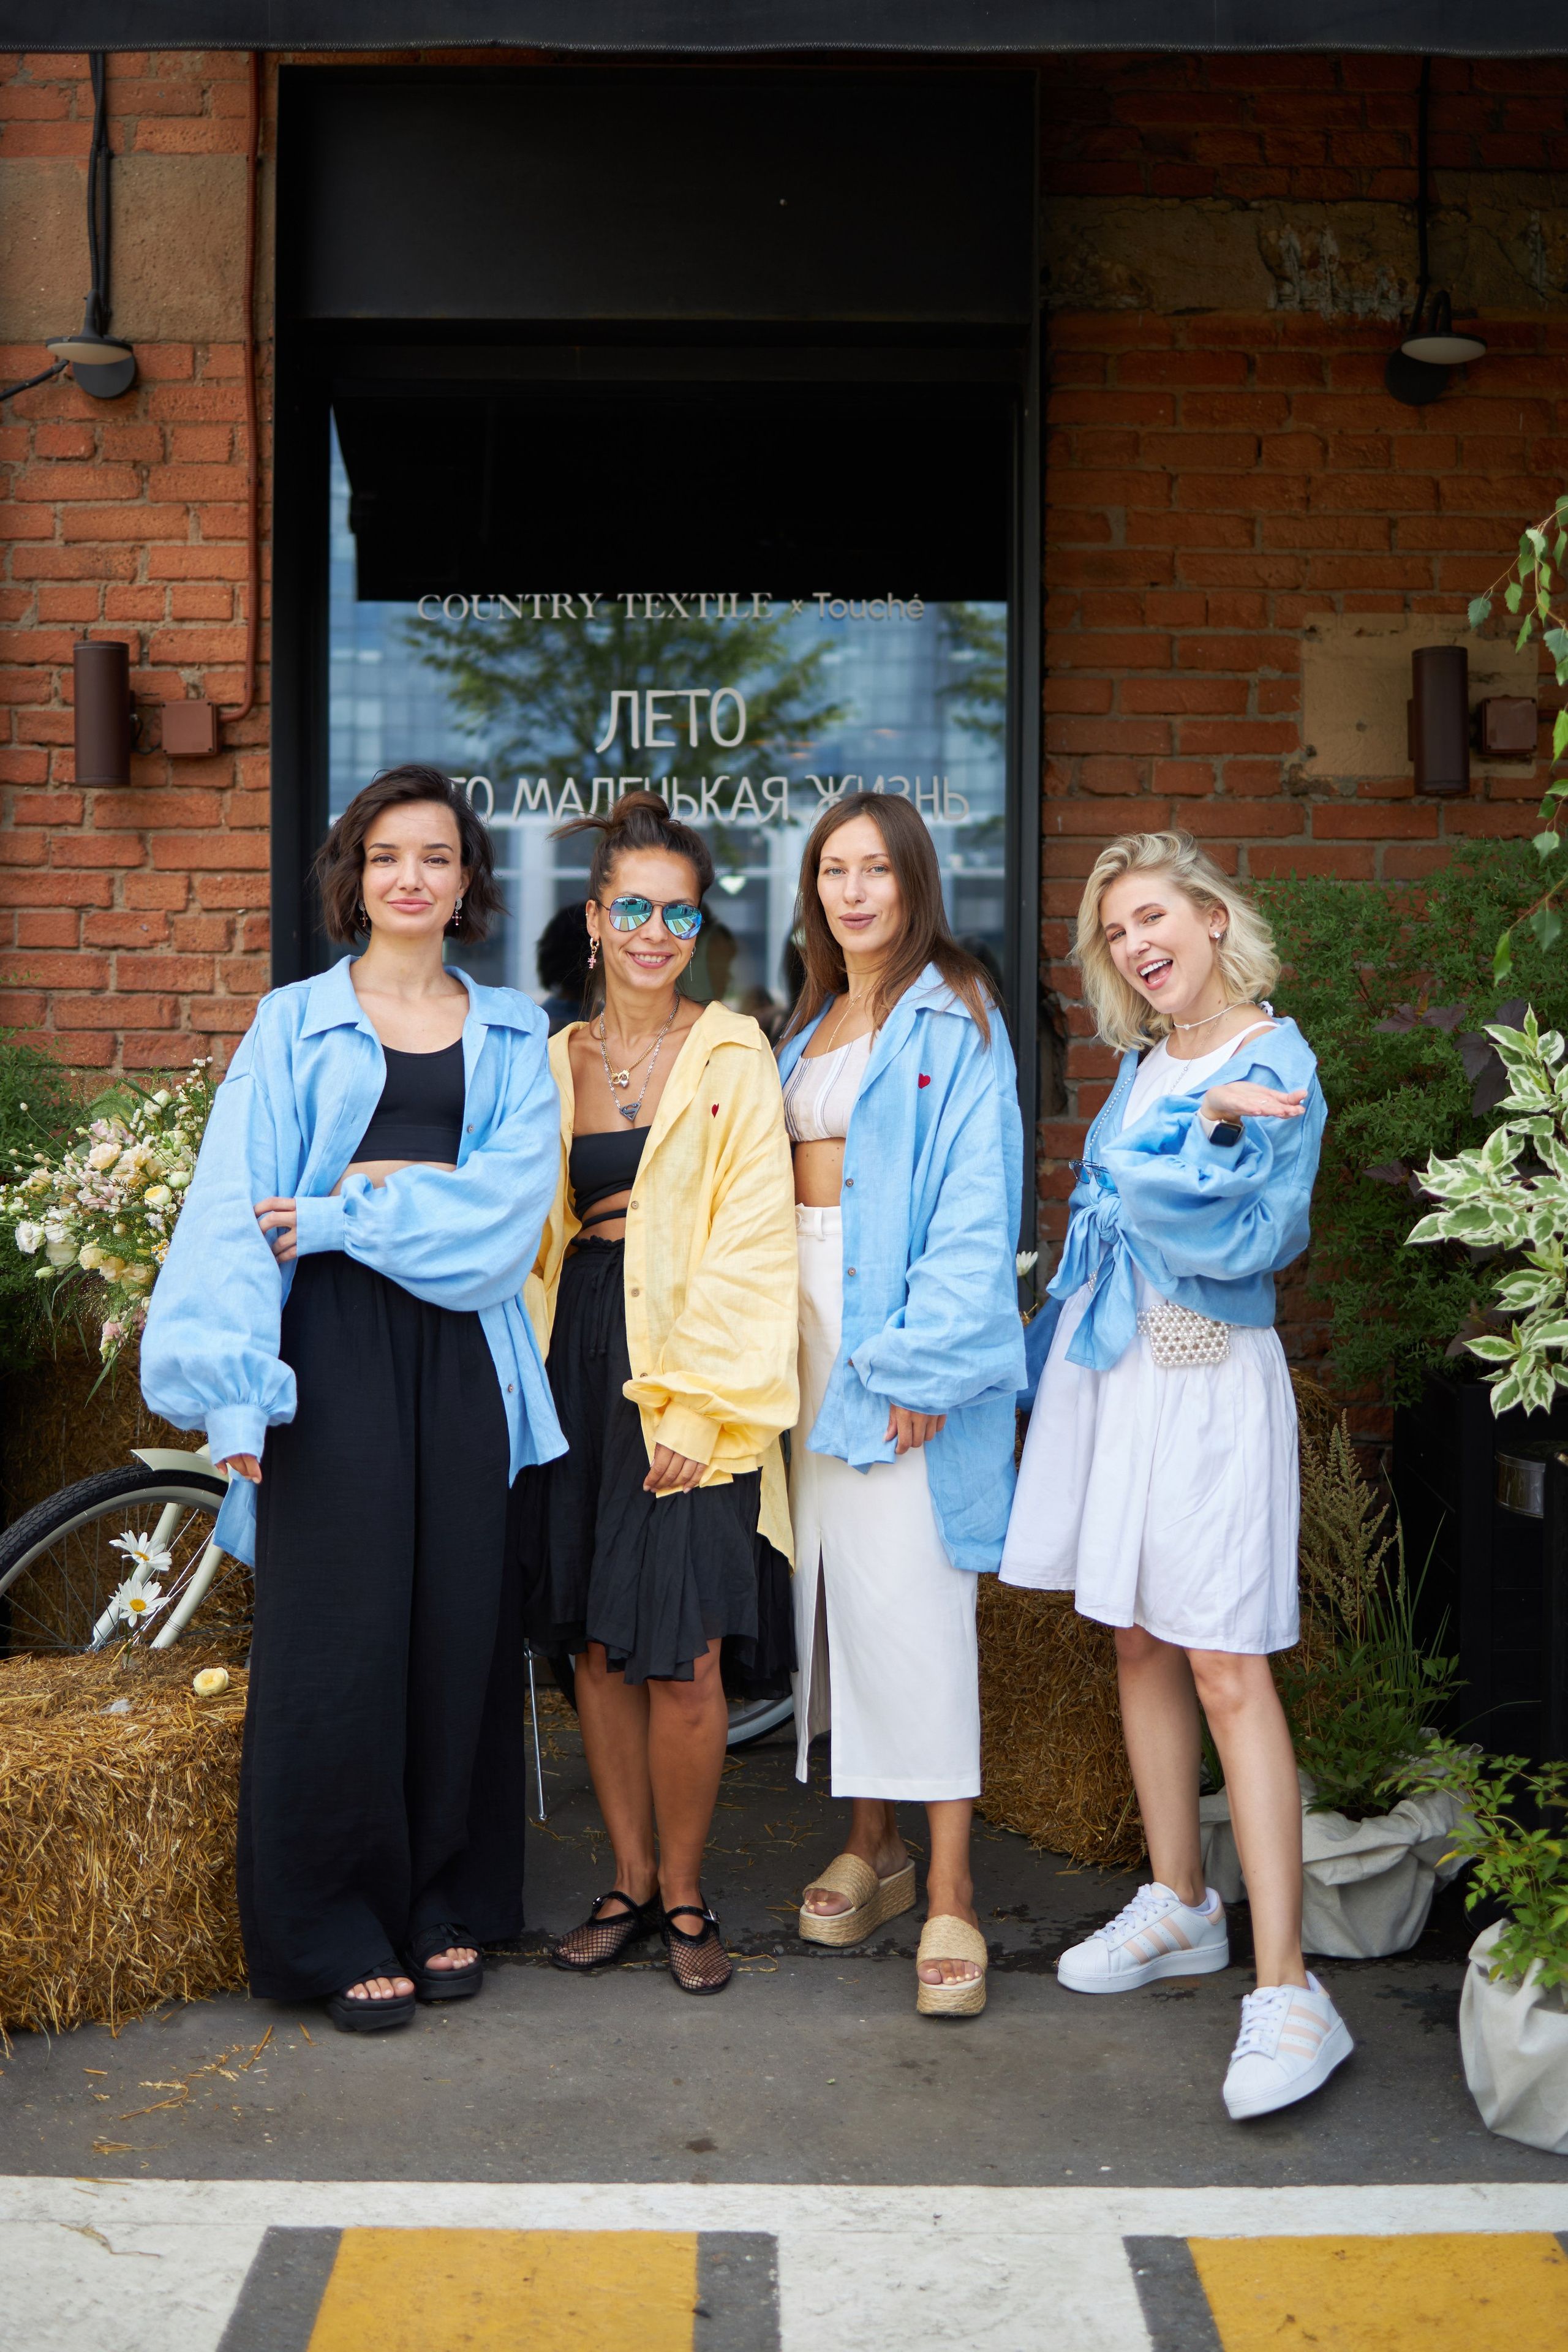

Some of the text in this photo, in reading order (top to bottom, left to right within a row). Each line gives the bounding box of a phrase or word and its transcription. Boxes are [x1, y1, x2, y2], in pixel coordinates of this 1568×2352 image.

[417, 593, 603, 620] COUNTRY
[617, 592, 773, 619] TEXTILE
[812, 592, 925, 620] Touché
[595, 687, 747, 754] ЛЕТО
